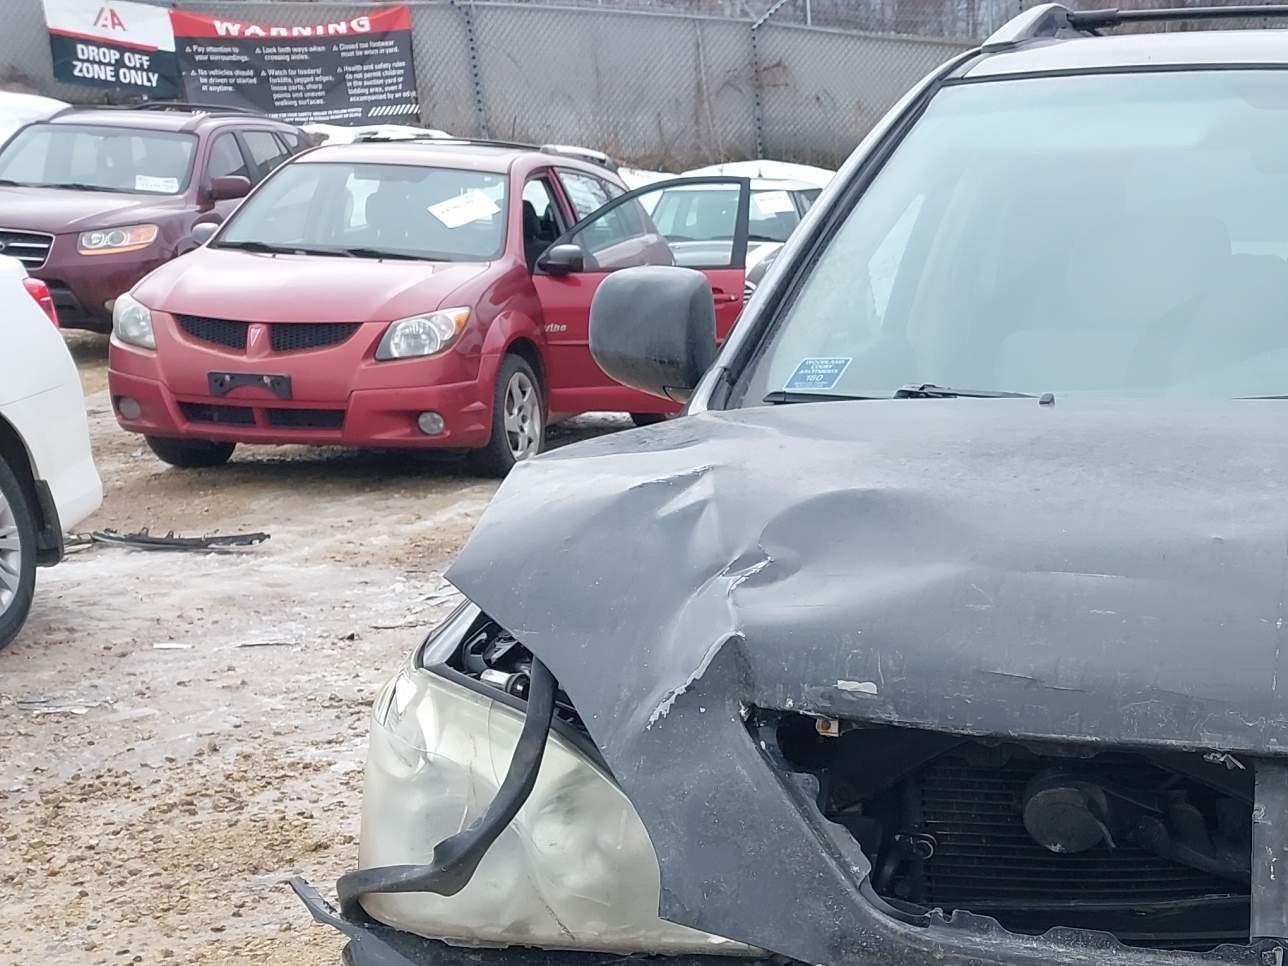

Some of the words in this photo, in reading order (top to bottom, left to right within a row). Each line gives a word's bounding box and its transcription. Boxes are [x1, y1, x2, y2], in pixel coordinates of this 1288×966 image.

[213, 16, 371, 36] WARNING
[76, 44, 120, 64] DROP
[124, 52, 150, 69] OFF
[72, 61, 116, 82] ZONE
[119, 68, 159, 87] ONLY
